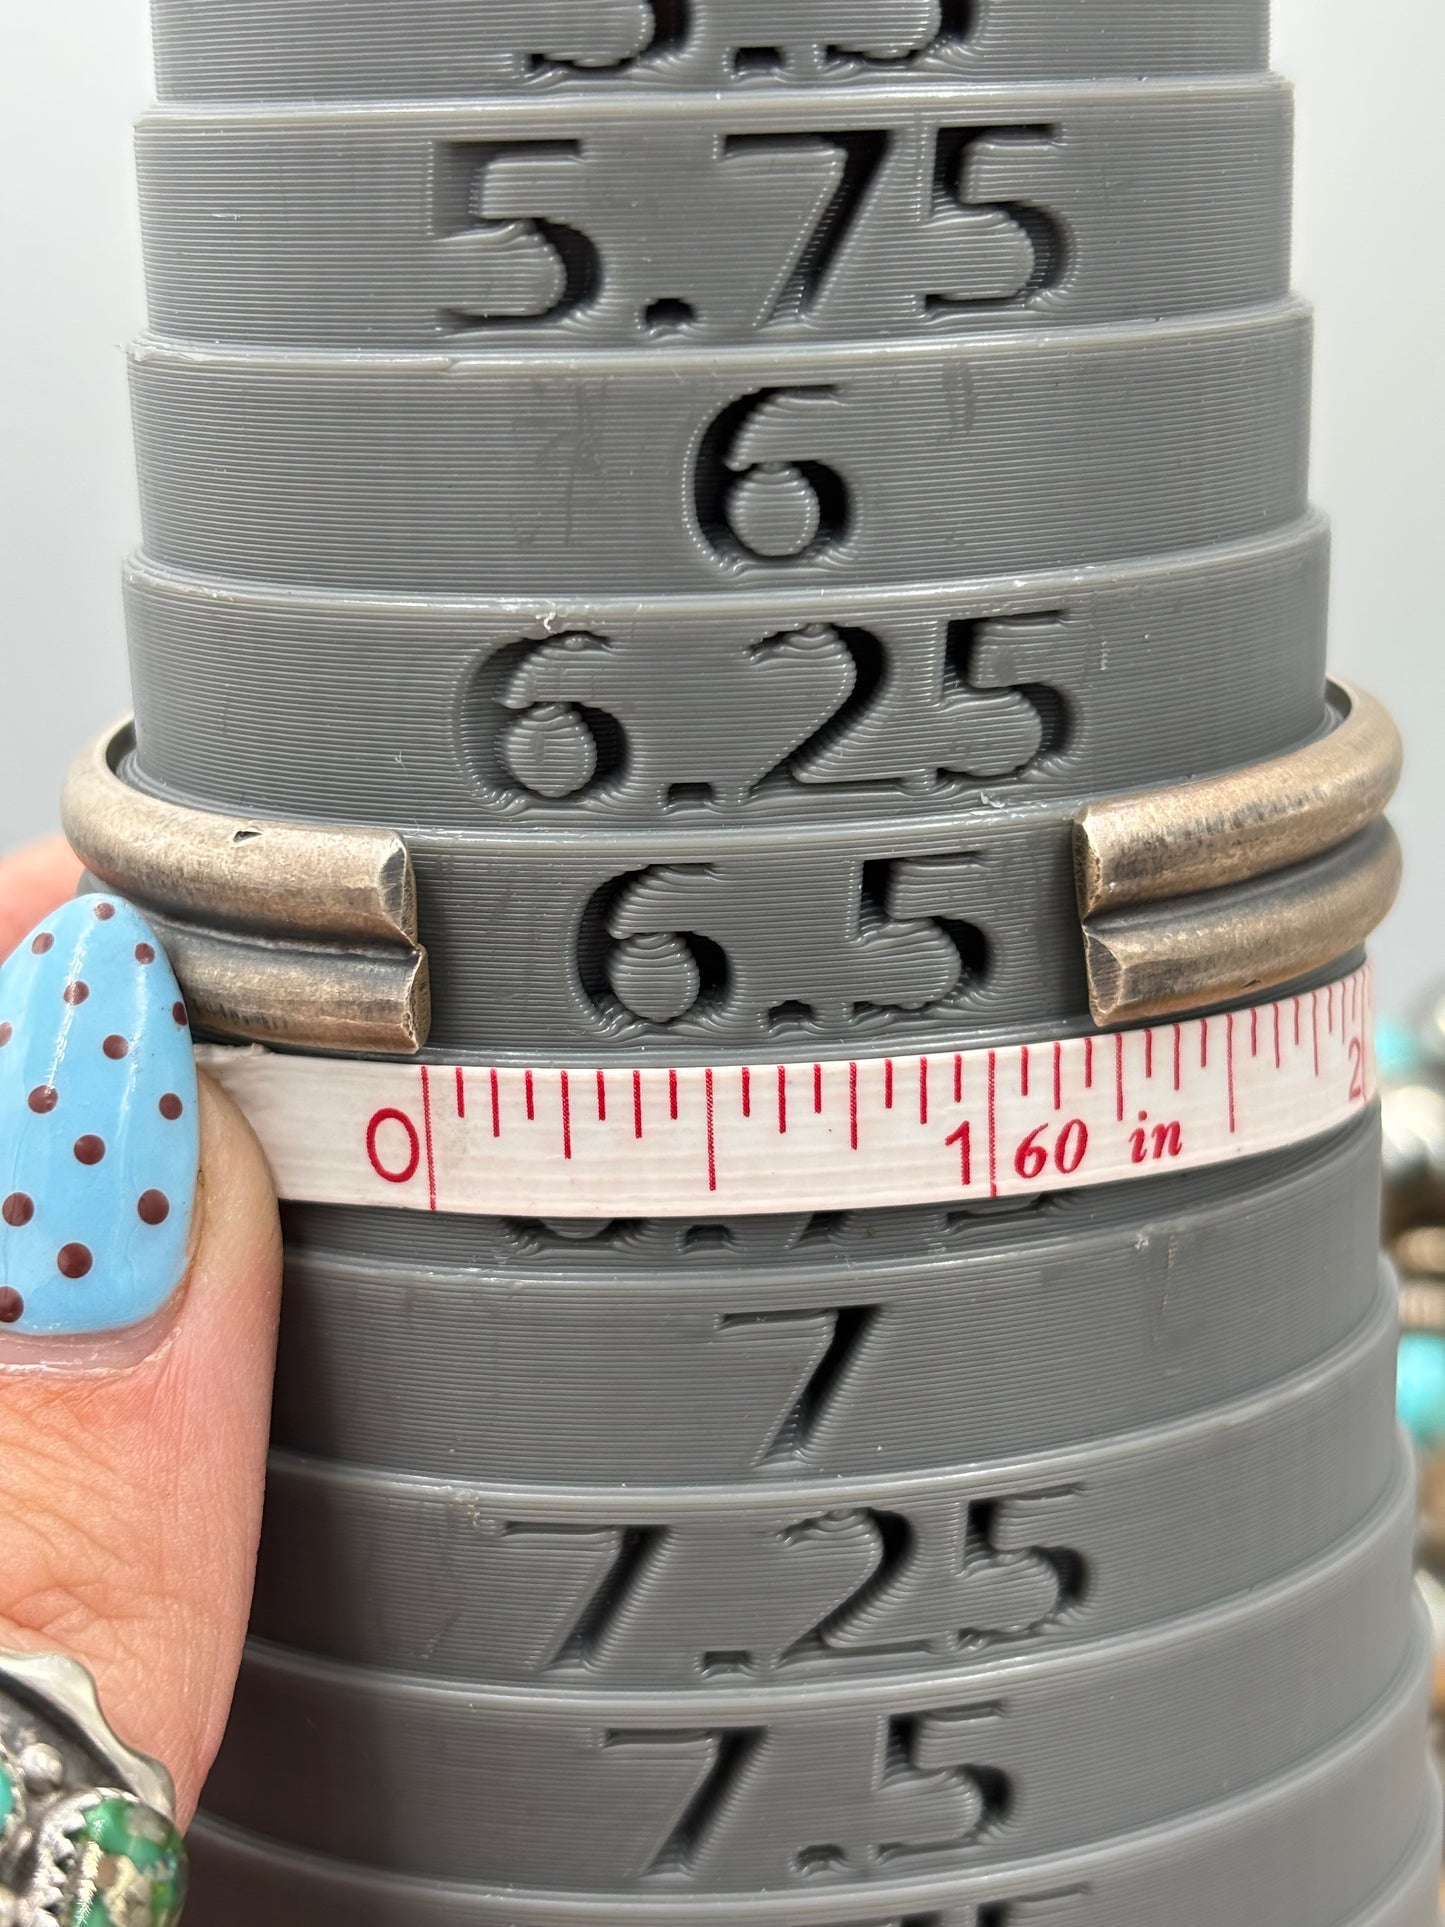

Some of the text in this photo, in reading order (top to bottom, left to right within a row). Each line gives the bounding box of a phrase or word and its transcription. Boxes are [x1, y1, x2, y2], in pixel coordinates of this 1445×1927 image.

[430, 123, 1080, 337] 5.75
[682, 383, 862, 573] 6
[456, 608, 1085, 812] 6.25
[569, 852, 994, 1036] 6.5
[366, 1107, 420, 1183] 0
[944, 1120, 971, 1185] 1
[1013, 1118, 1089, 1179] 60
[1128, 1110, 1182, 1164] in
[716, 1303, 886, 1467] 7
[485, 1482, 1094, 1677] 7.25
[597, 1698, 1018, 1877] 7.5
